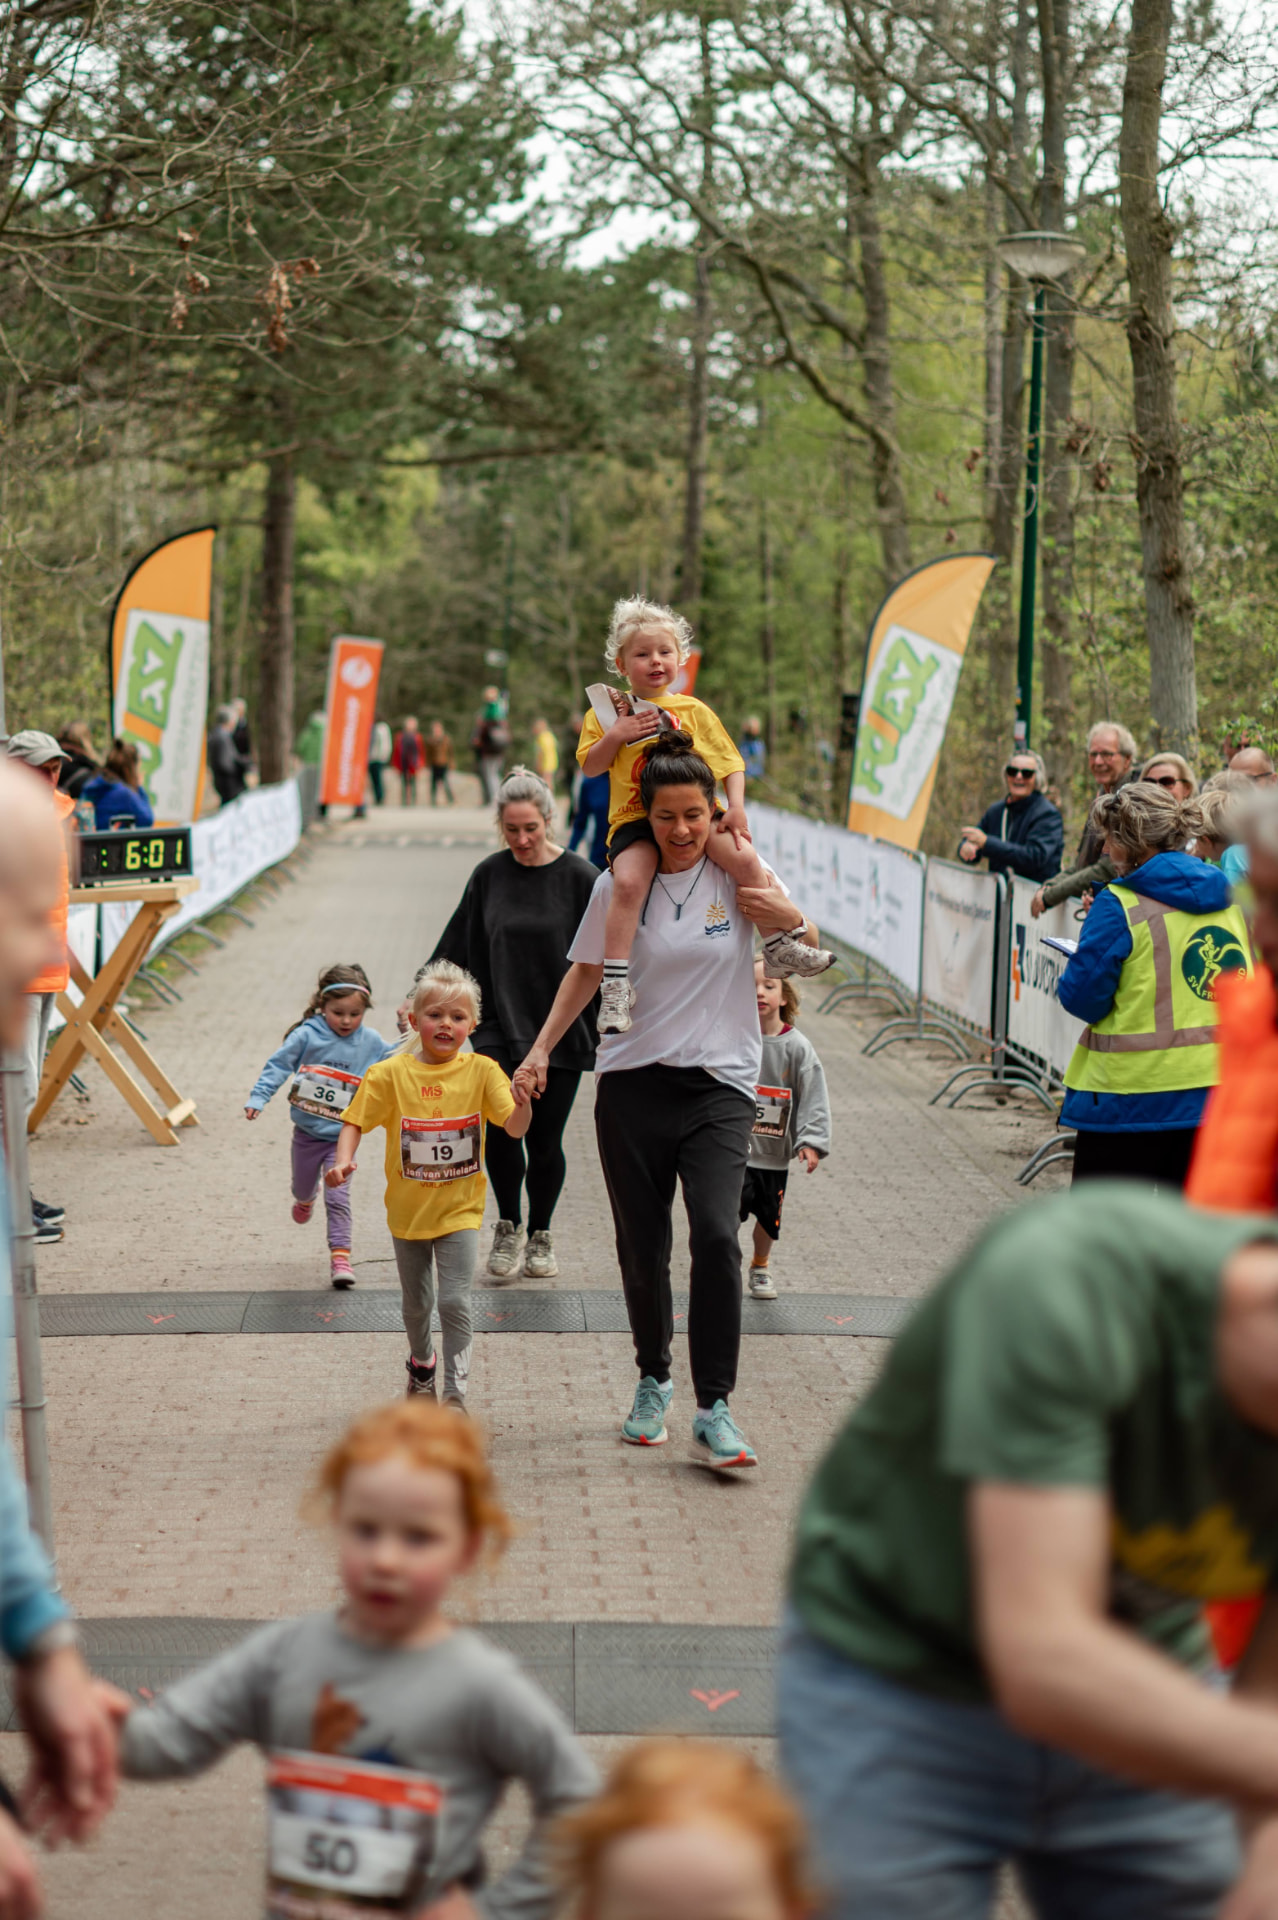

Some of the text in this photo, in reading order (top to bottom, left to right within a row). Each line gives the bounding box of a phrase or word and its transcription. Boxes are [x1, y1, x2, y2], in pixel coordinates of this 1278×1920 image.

[125, 839, 183, 870] 6:01
[313, 1086, 336, 1102] 36
[421, 1085, 443, 1097] MS
[431, 1145, 453, 1161] 19
[406, 1167, 421, 1177] Jan
[443, 1161, 478, 1178] Vlieland
[304, 1831, 359, 1877] 50
